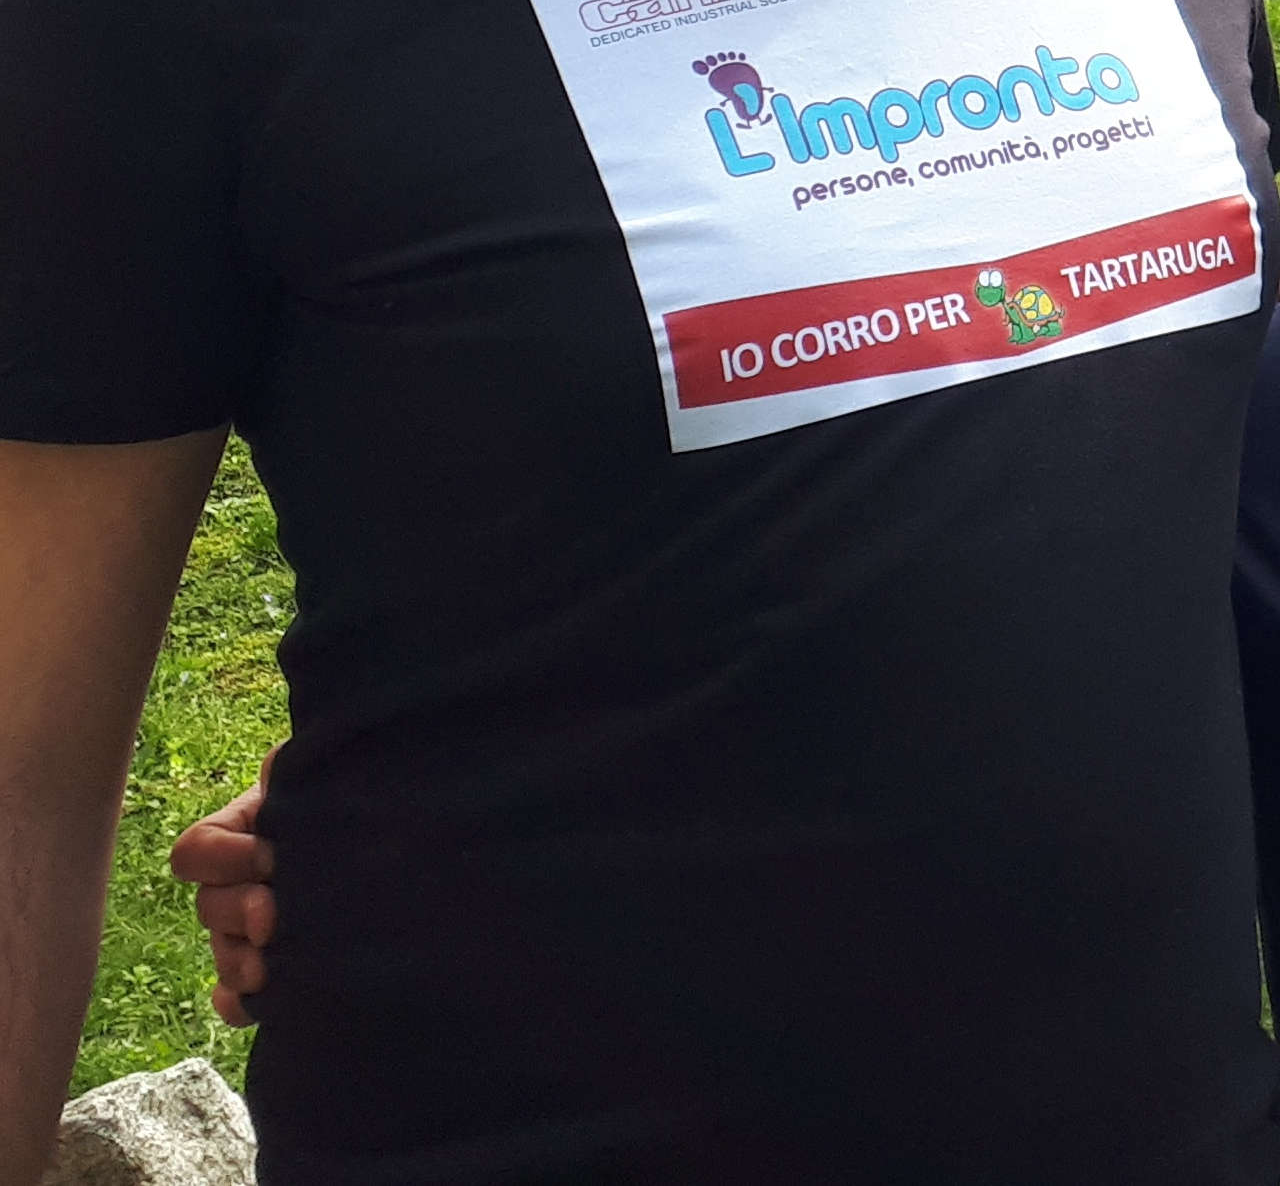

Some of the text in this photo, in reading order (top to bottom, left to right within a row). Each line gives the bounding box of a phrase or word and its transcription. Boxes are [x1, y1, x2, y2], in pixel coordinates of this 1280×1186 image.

[590, 19, 672, 48] DEDICATED
[674, 0, 757, 28] INDUSTRIAL
[792, 115, 1155, 210] persone, comunità, progetti
[719, 234, 1236, 383] IO CORRO PER TARTARUGA
